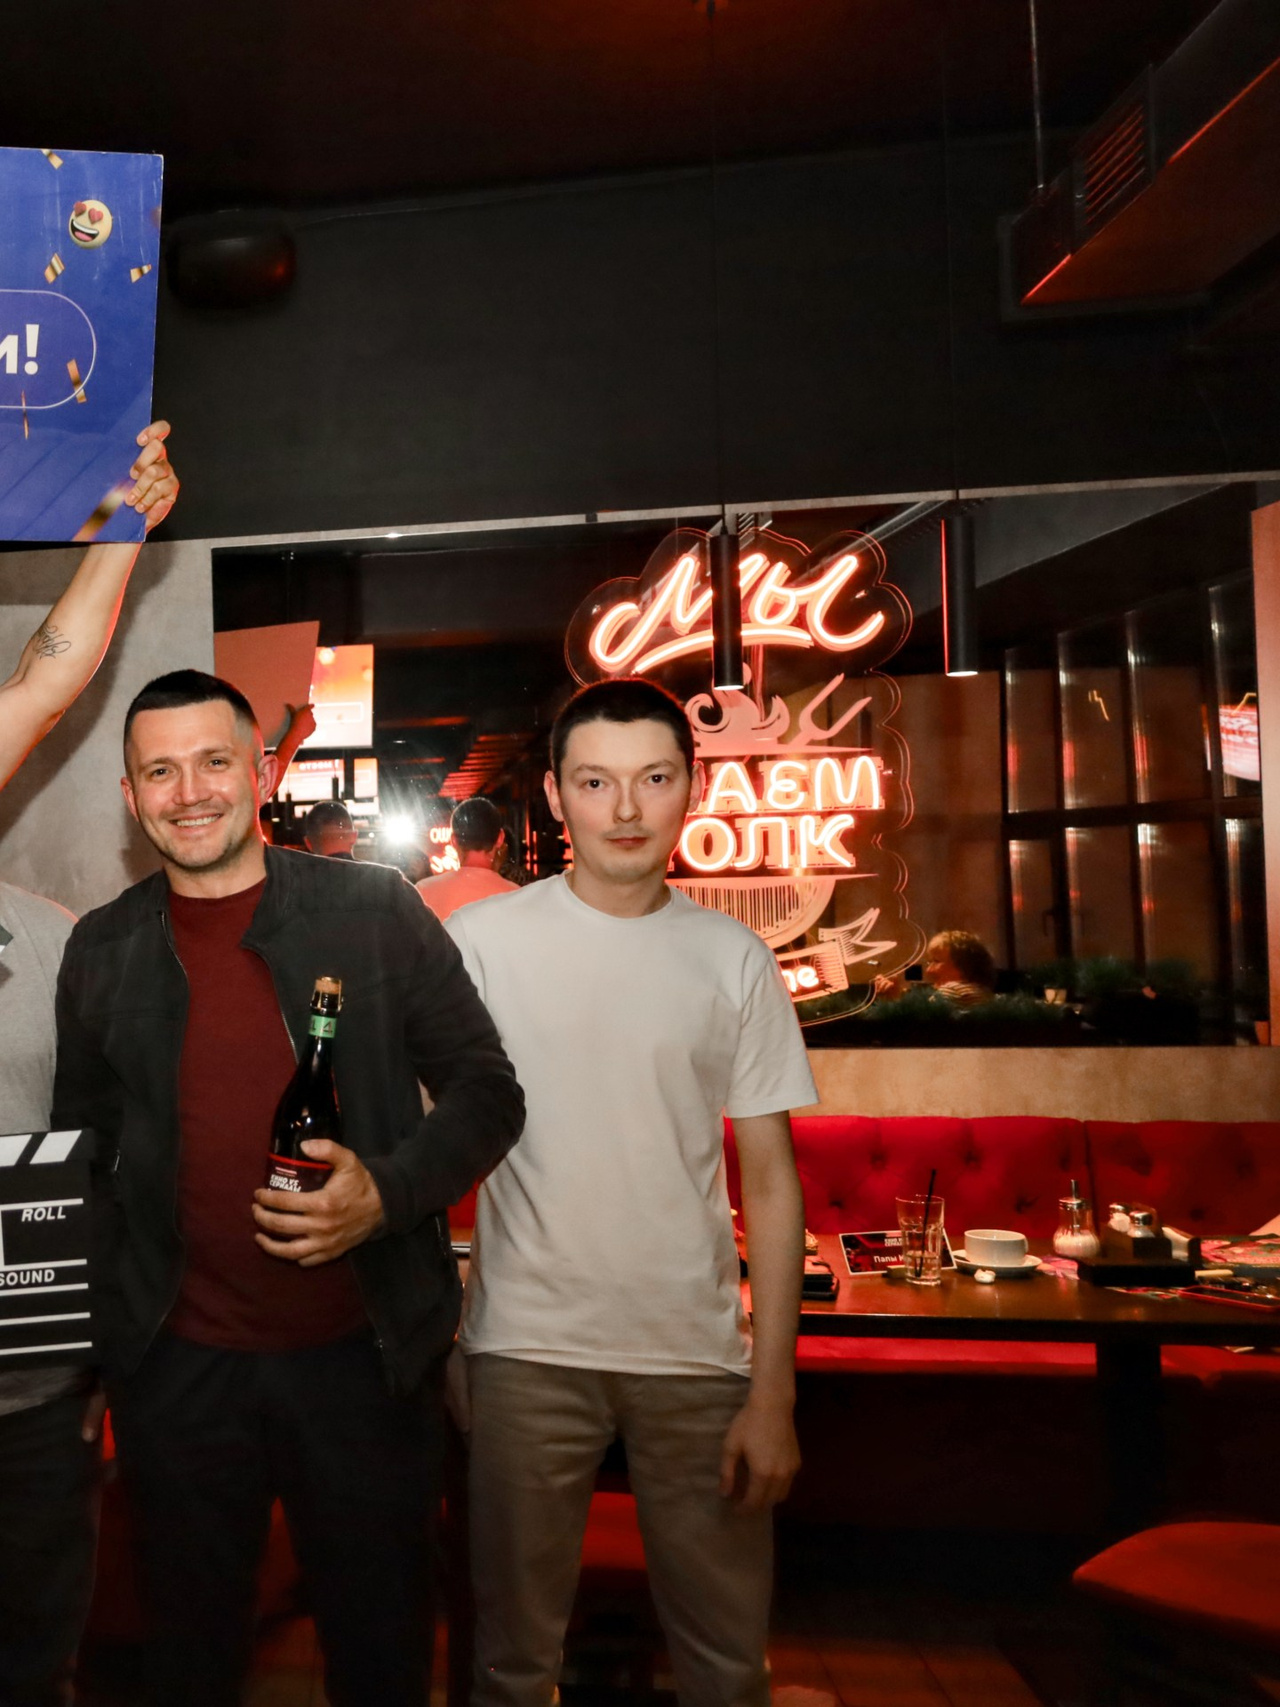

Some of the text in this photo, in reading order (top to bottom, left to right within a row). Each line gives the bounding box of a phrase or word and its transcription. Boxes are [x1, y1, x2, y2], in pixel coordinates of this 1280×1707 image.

[705, 755, 886, 811] АЕМ
[679, 813, 857, 872] ОЛК
[21, 1206, 67, 1223] ROLL
